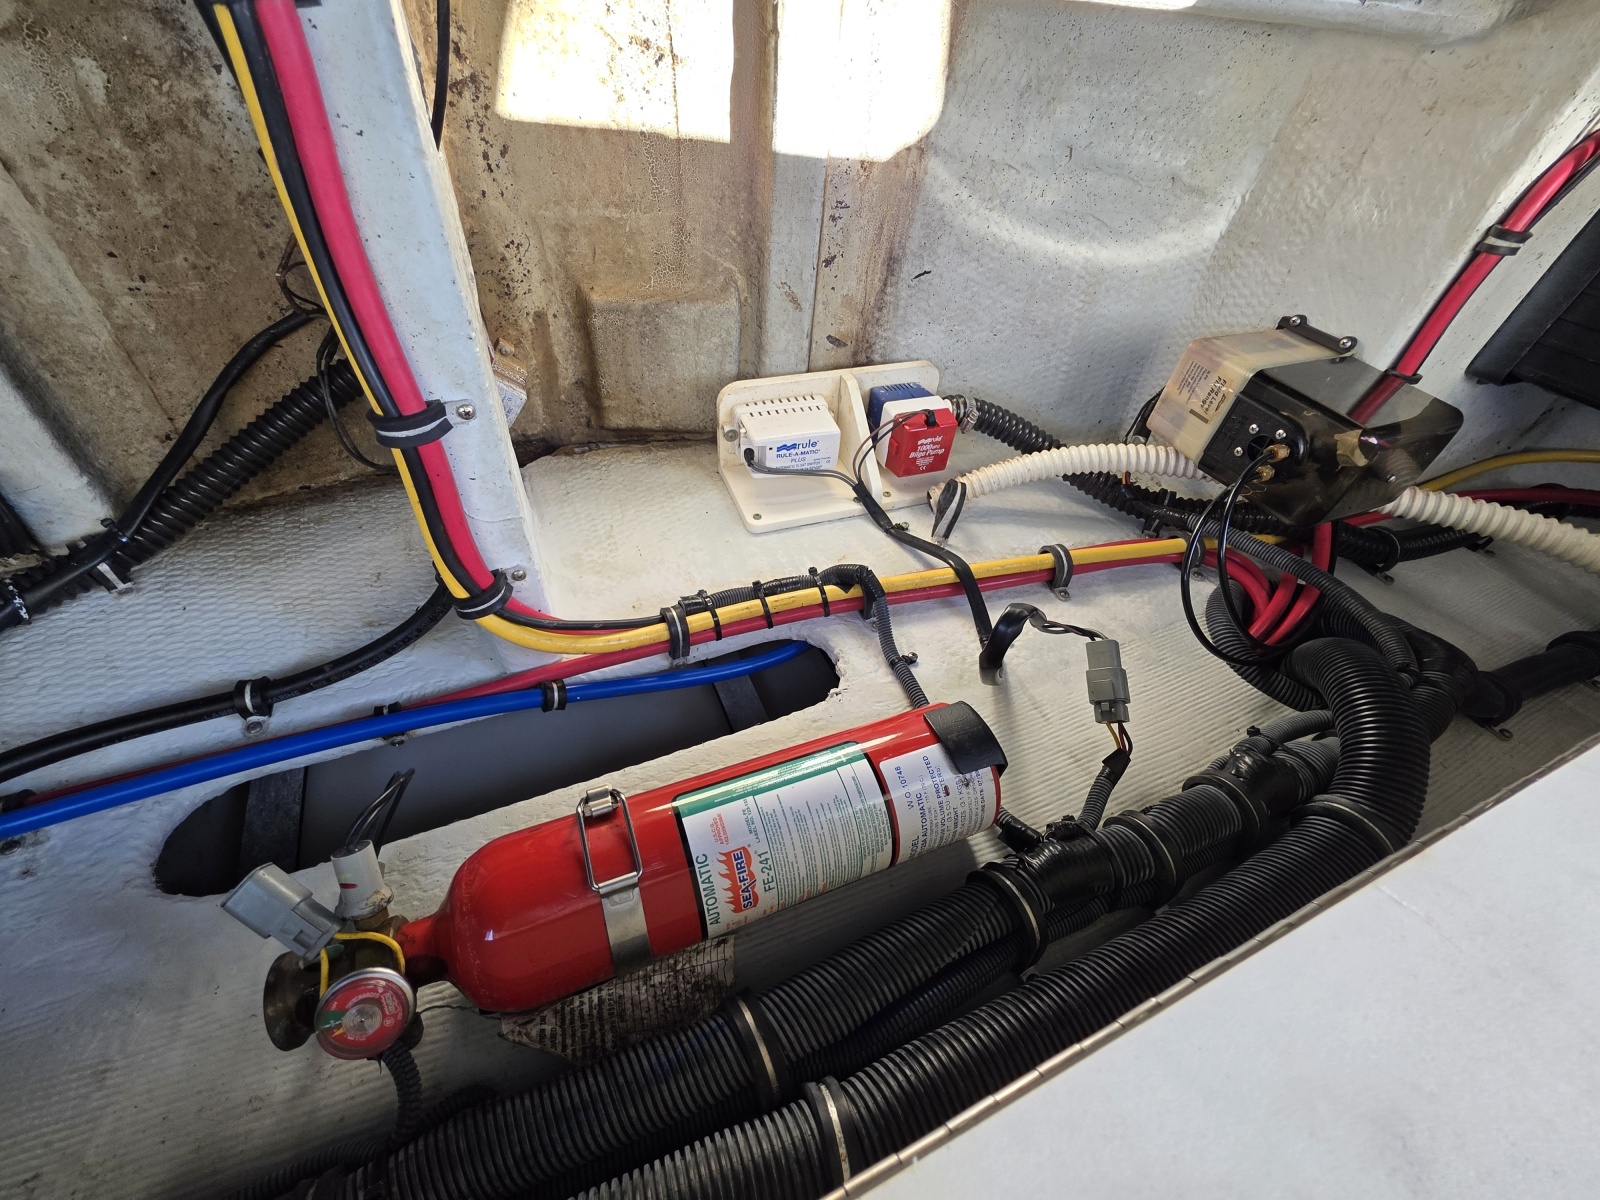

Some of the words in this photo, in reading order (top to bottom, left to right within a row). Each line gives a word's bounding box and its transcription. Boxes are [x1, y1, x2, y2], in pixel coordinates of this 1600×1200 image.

[797, 440, 818, 450] rule
[922, 755, 941, 798] PROTECTED
[713, 817, 724, 844] APPROVED
[694, 852, 720, 924] AUTOMATIC
[758, 851, 775, 892] FE-241
